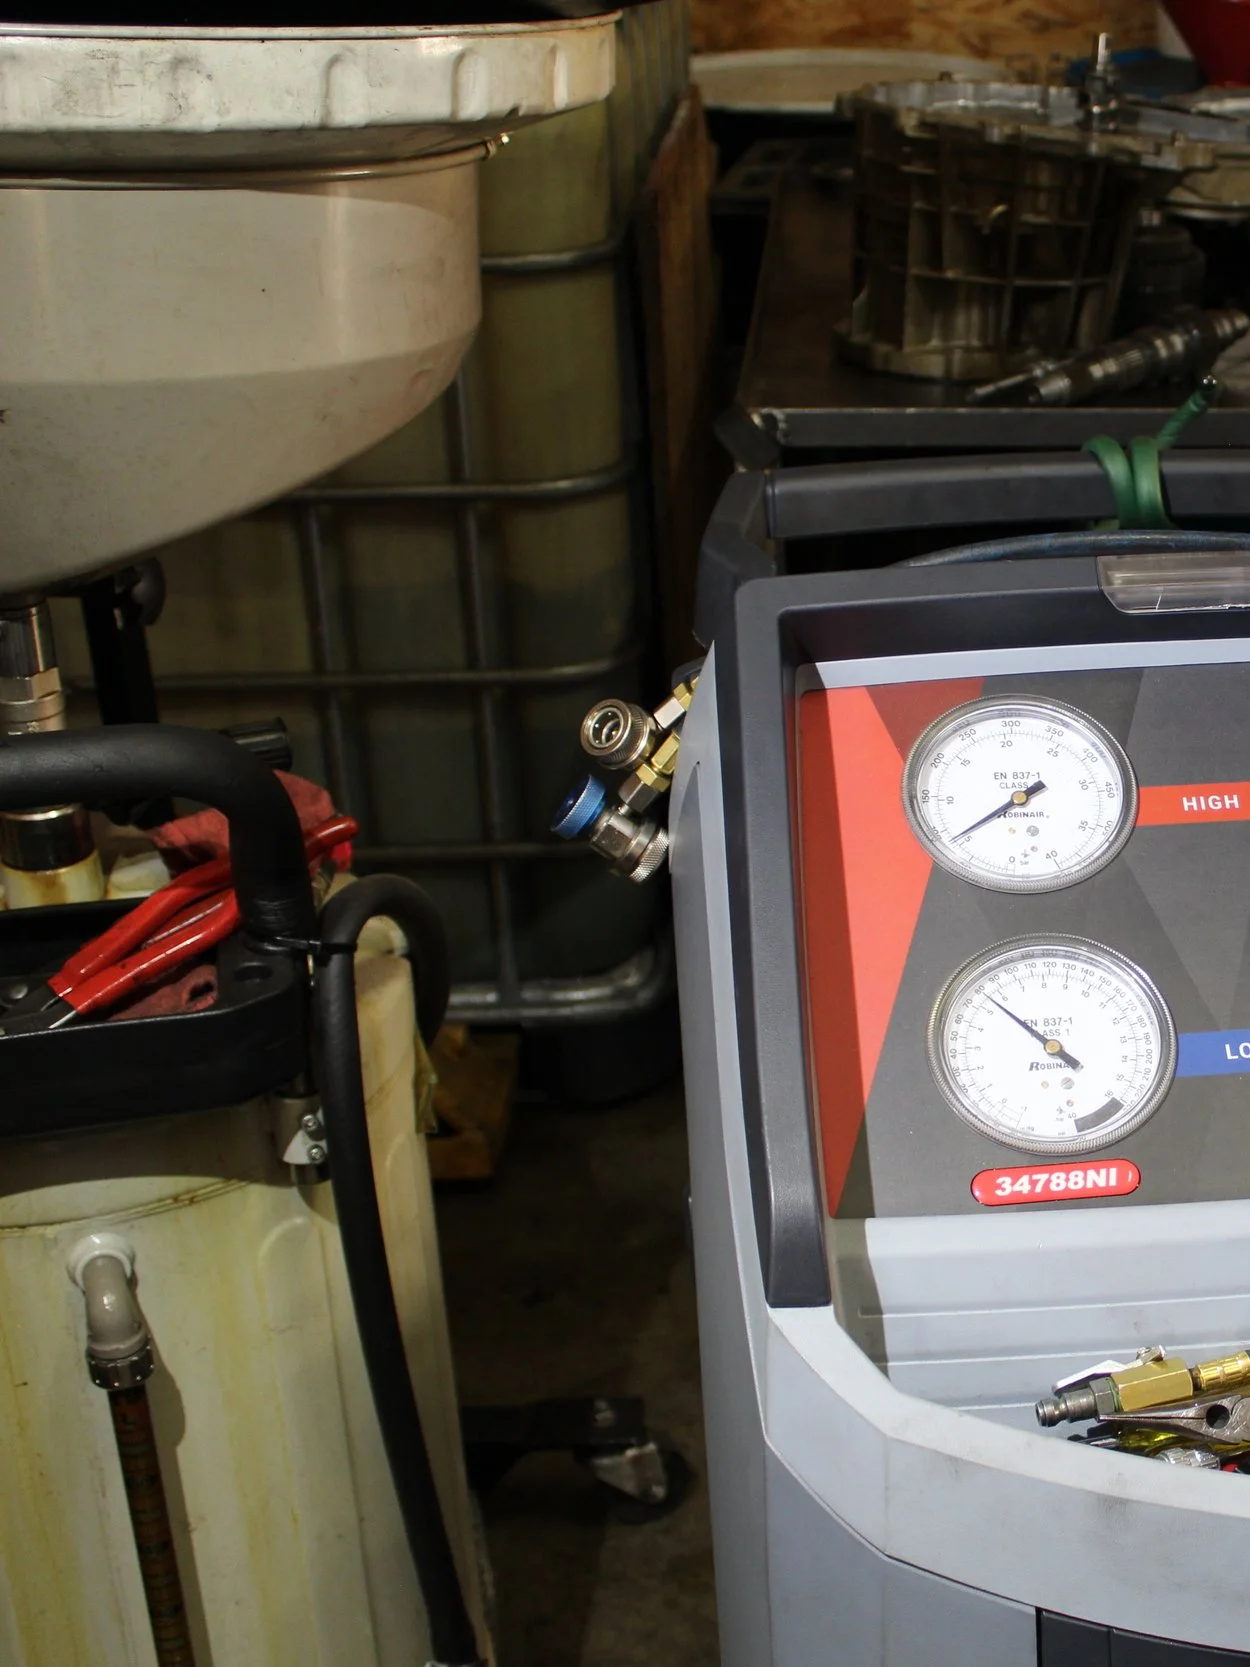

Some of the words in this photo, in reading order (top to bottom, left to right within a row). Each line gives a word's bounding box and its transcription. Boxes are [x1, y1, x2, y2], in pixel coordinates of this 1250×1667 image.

[958, 728, 977, 741] 250
[1045, 725, 1064, 737] 350
[1000, 740, 1013, 748] 20
[1046, 748, 1060, 757] 25
[1082, 747, 1098, 763] 400
[930, 752, 945, 769] 200
[960, 758, 971, 767] 15
[993, 772, 1007, 780] EN
[1012, 771, 1041, 779] 837-1
[1079, 779, 1089, 791] 30
[1105, 781, 1116, 799] 450
[921, 789, 930, 804] 150
[946, 796, 954, 805] 10
[1182, 794, 1240, 812] HIGH
[1078, 820, 1089, 832] 35
[1045, 850, 1058, 859] 40
[1004, 966, 1020, 976] 100
[1024, 962, 1037, 970] 110
[1062, 962, 1077, 971] 130
[1081, 967, 1095, 977] 140
[988, 974, 1000, 984] 90
[1099, 976, 1112, 987] 150
[974, 984, 986, 996] 80
[1081, 990, 1090, 998] 10
[1113, 986, 1126, 999] 160
[963, 998, 974, 1009] 70
[1126, 999, 1138, 1012] 170
[954, 1013, 964, 1025] 60
[1043, 1017, 1073, 1027] 837-1
[1136, 1015, 1147, 1028] 180
[950, 1031, 959, 1041] 50
[1120, 1035, 1128, 1044] 13
[1143, 1032, 1152, 1045] 190
[949, 1049, 957, 1059] 40
[1121, 1055, 1128, 1063] 14
[1145, 1048, 1153, 1065] 200
[953, 1066, 961, 1077] 30
[1116, 1073, 1125, 1081] 15
[1142, 1067, 1152, 1081] 210
[1104, 1090, 1114, 1098] 16
[1134, 1083, 1146, 1097] 220
[995, 1168, 1117, 1196] 34788NI
